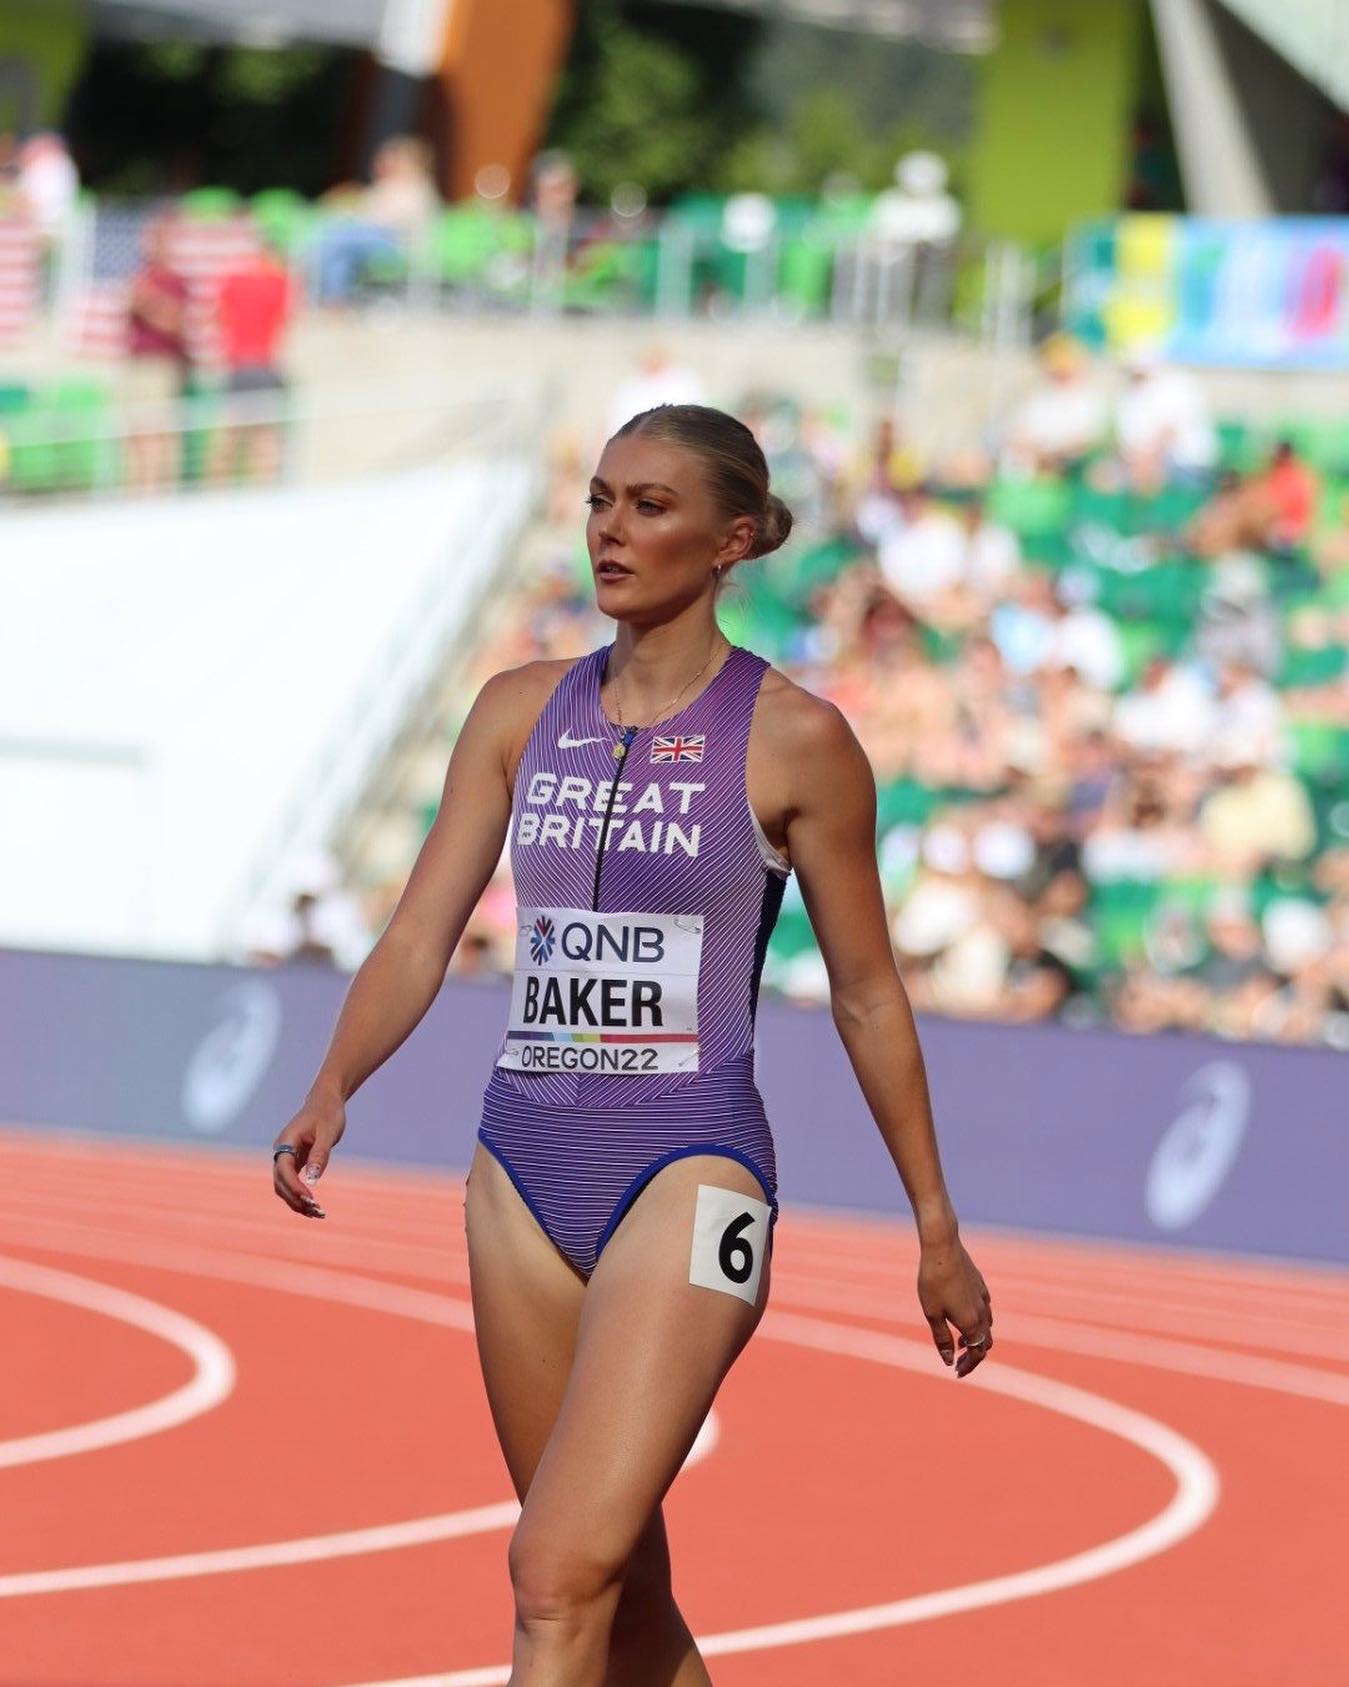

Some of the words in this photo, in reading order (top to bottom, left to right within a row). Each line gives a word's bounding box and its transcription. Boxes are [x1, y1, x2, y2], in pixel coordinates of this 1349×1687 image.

[527, 773, 705, 815] GREAT
[517, 814, 701, 857] BRITAIN
[562, 923, 664, 963] QNB
[524, 976, 663, 1027] BAKER
[522, 1046, 658, 1070] OREGON22
[719, 1213, 755, 1283] 6
